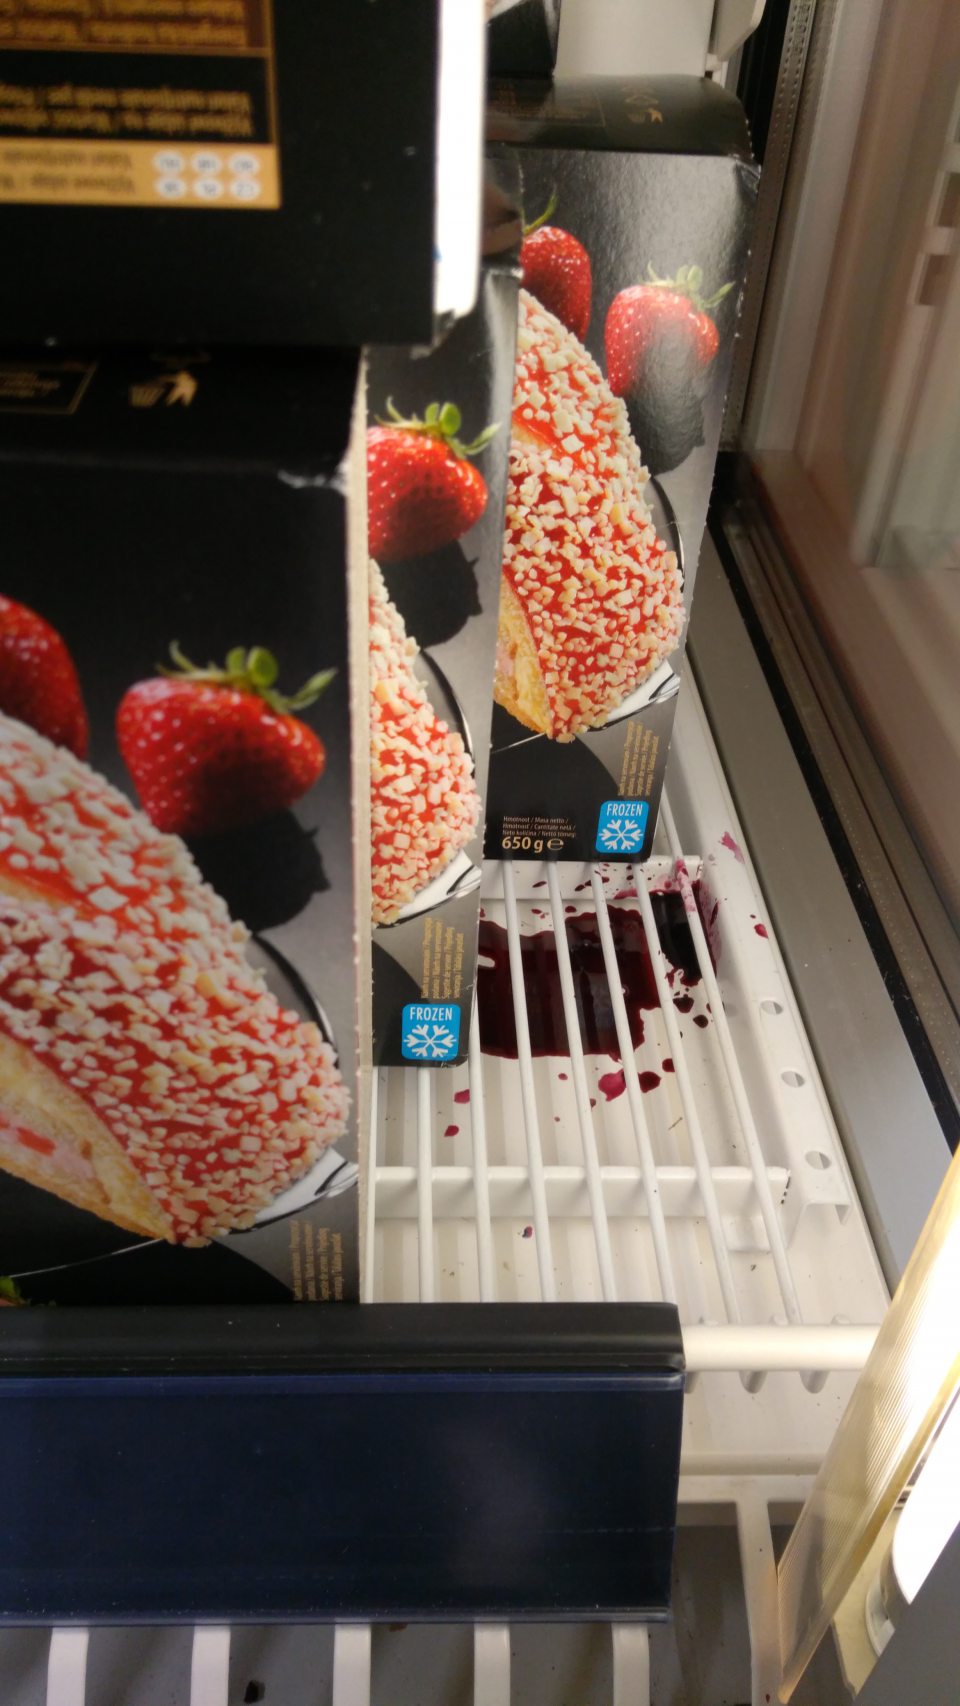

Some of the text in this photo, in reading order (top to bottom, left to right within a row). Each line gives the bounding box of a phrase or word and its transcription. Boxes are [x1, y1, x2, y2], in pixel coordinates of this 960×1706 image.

[606, 804, 643, 816] FROZEN
[502, 836, 531, 849] 650
[534, 839, 544, 853] g
[410, 1006, 453, 1021] FROZEN
